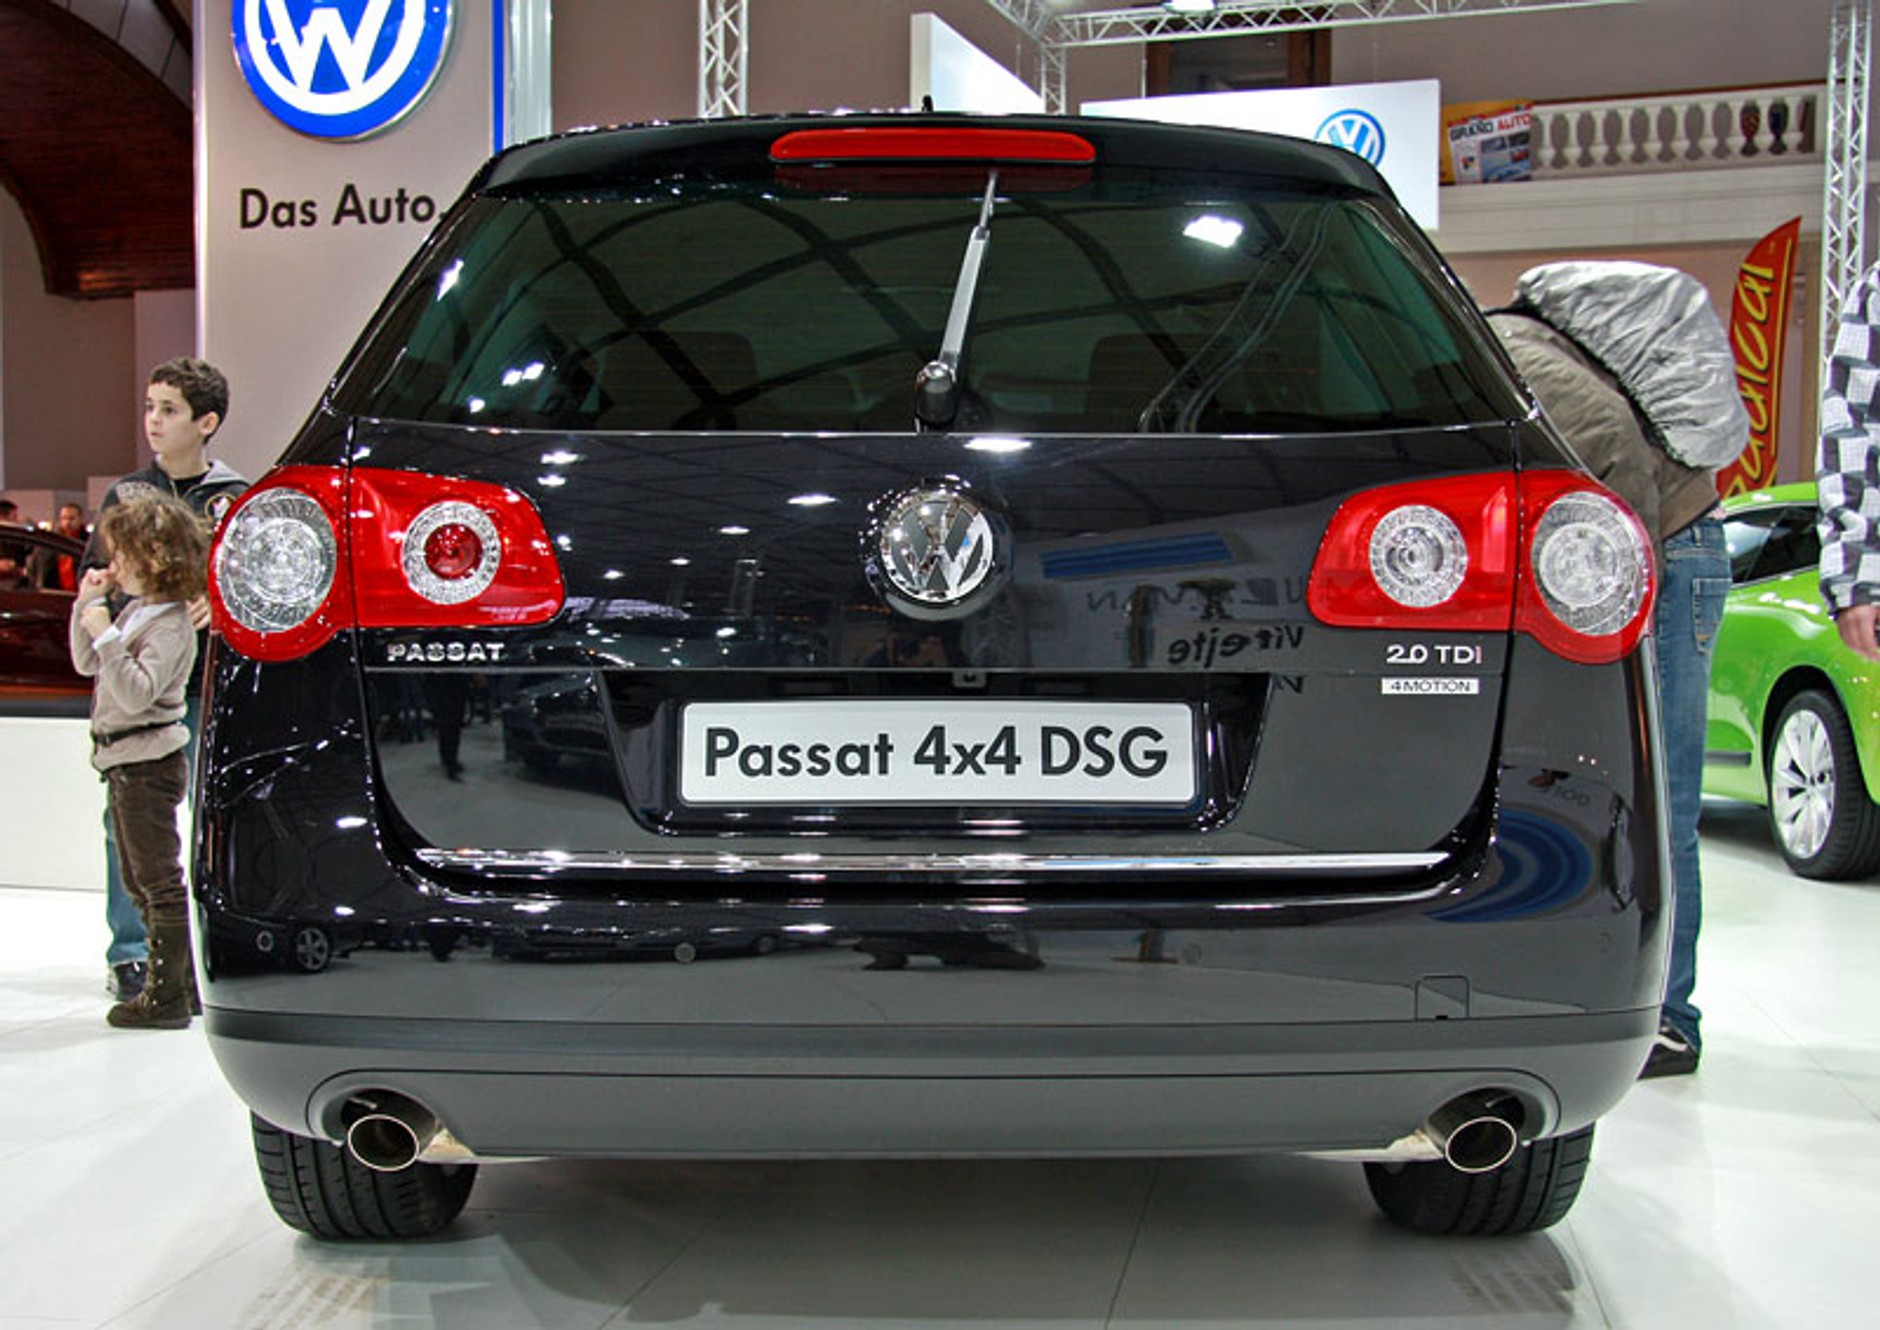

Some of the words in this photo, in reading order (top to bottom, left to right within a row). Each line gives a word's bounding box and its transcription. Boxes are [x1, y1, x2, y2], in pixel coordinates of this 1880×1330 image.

[239, 187, 318, 229] Das
[387, 642, 505, 661] PASSAT
[1390, 680, 1471, 692] 4MOTION
[706, 726, 894, 777] Passat
[914, 725, 1022, 775] 4x4
[1040, 725, 1168, 778] DSG
